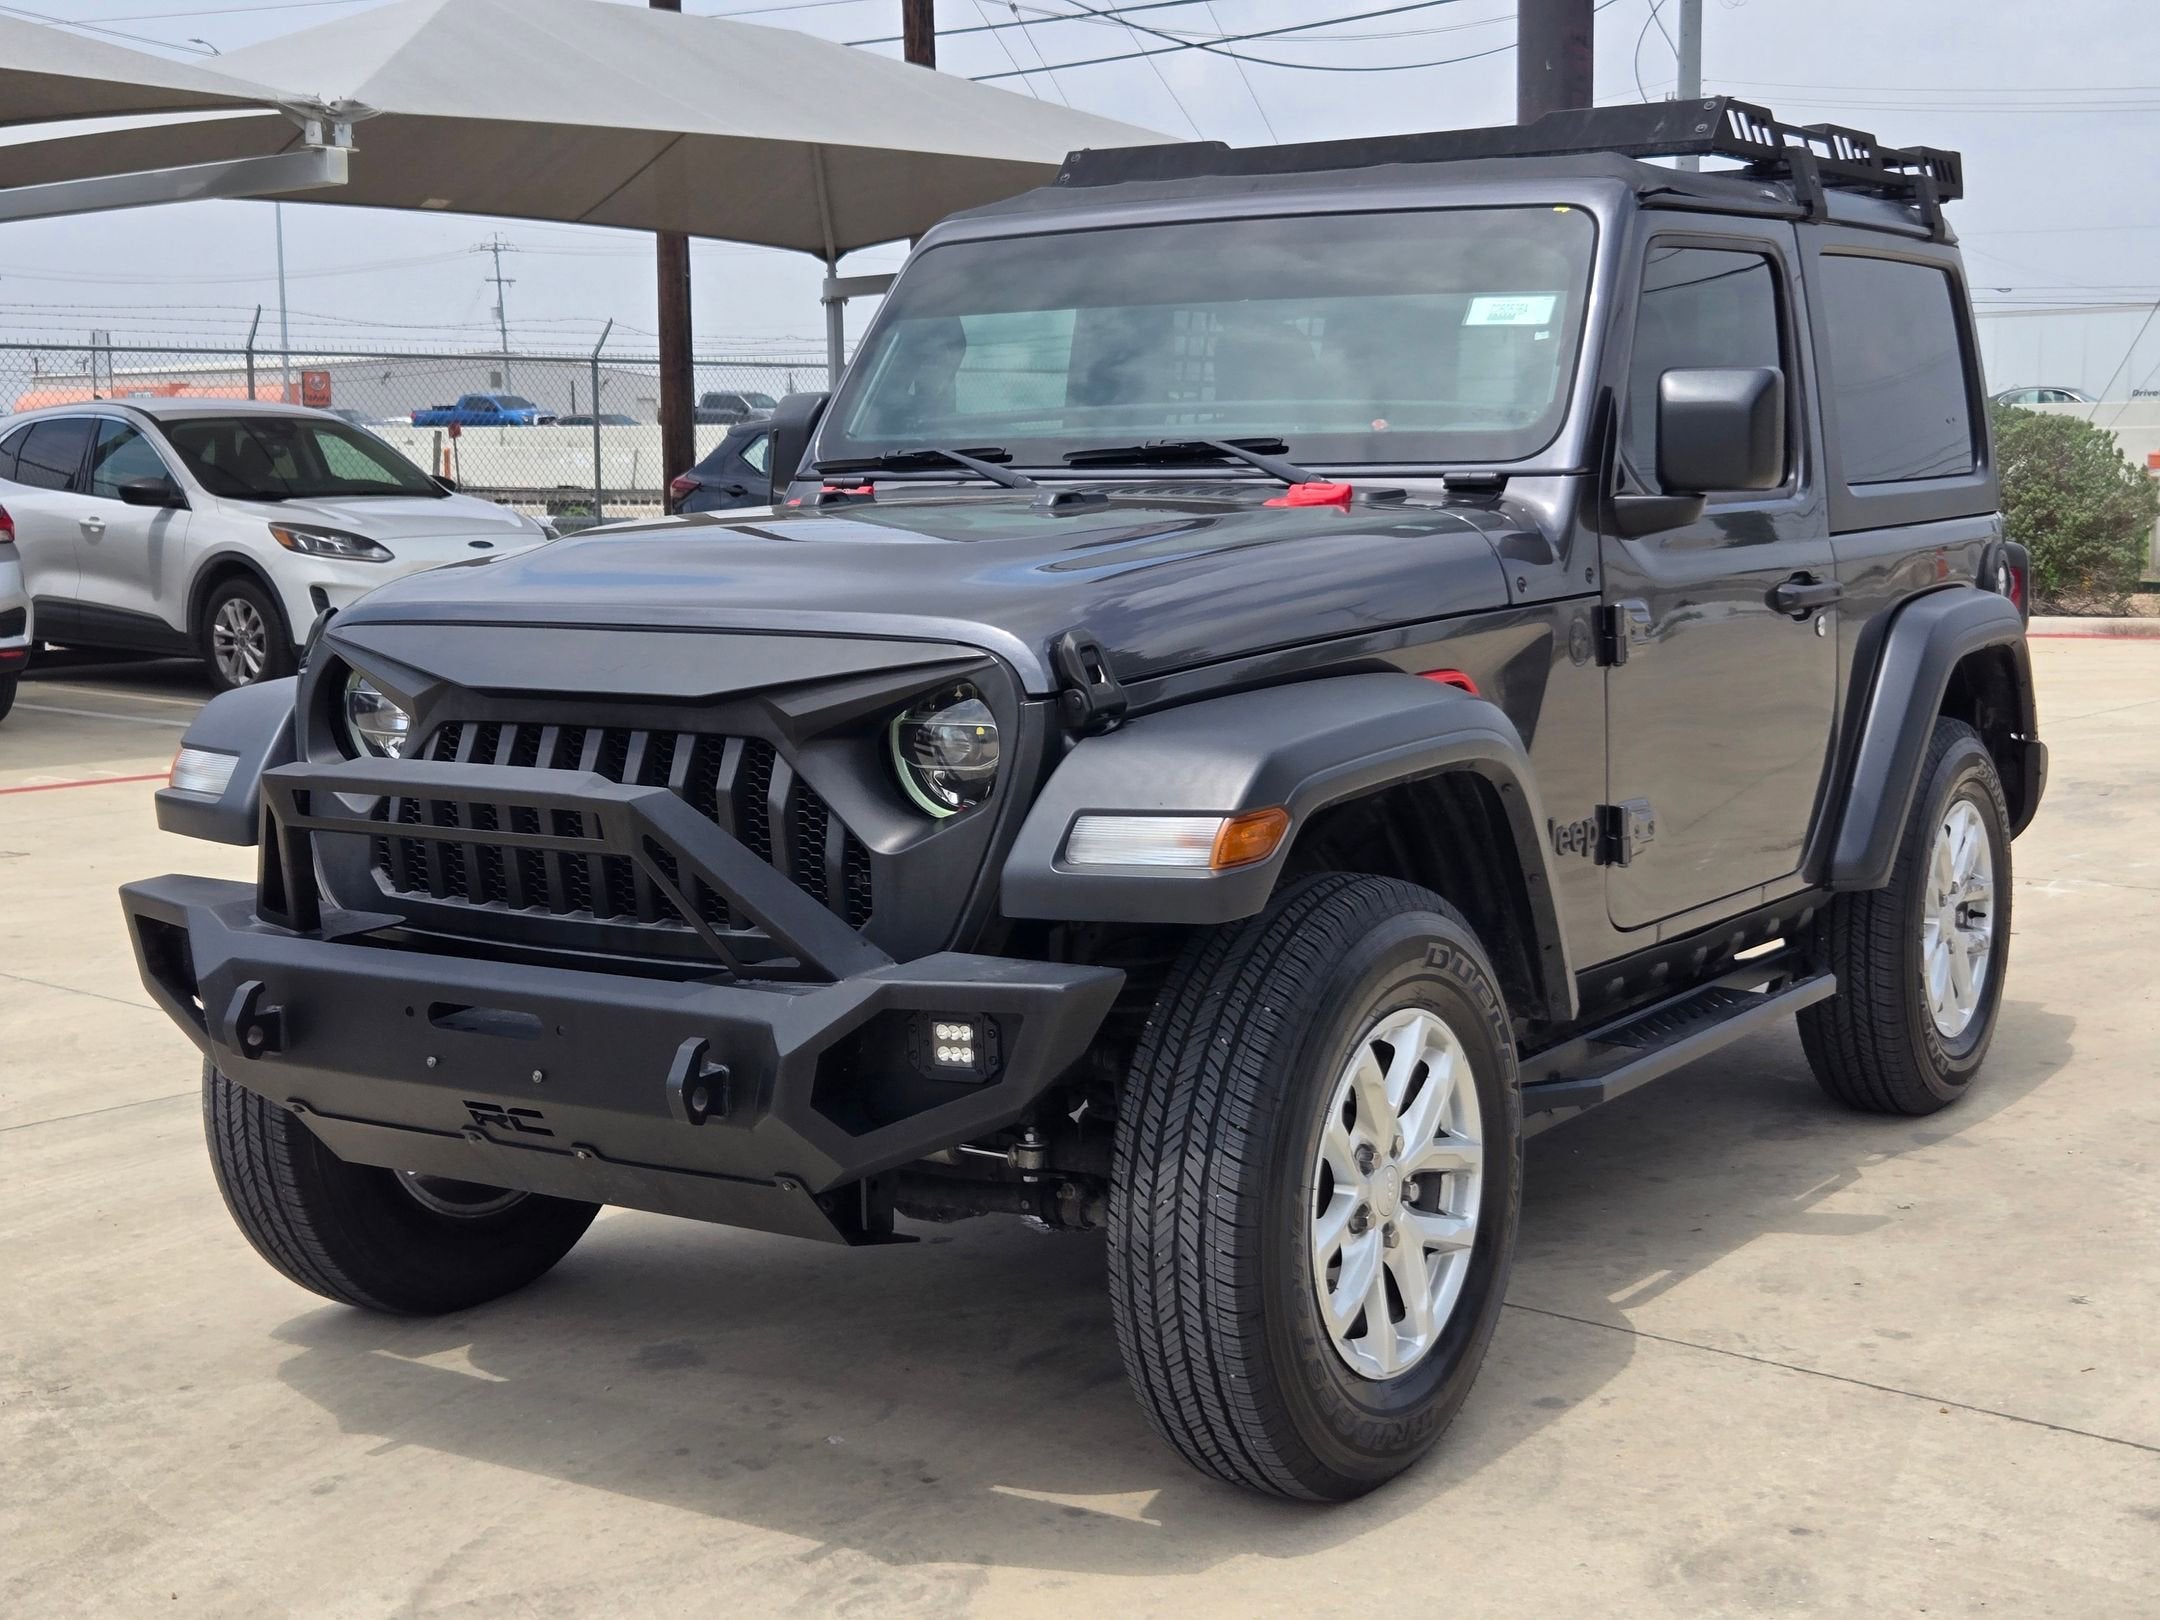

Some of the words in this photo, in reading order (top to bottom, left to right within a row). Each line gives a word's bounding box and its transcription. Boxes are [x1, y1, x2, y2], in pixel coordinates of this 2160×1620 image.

[2132, 389, 2160, 397] Drive
[1547, 816, 1599, 857] Jeep
[462, 1100, 556, 1137] RC
